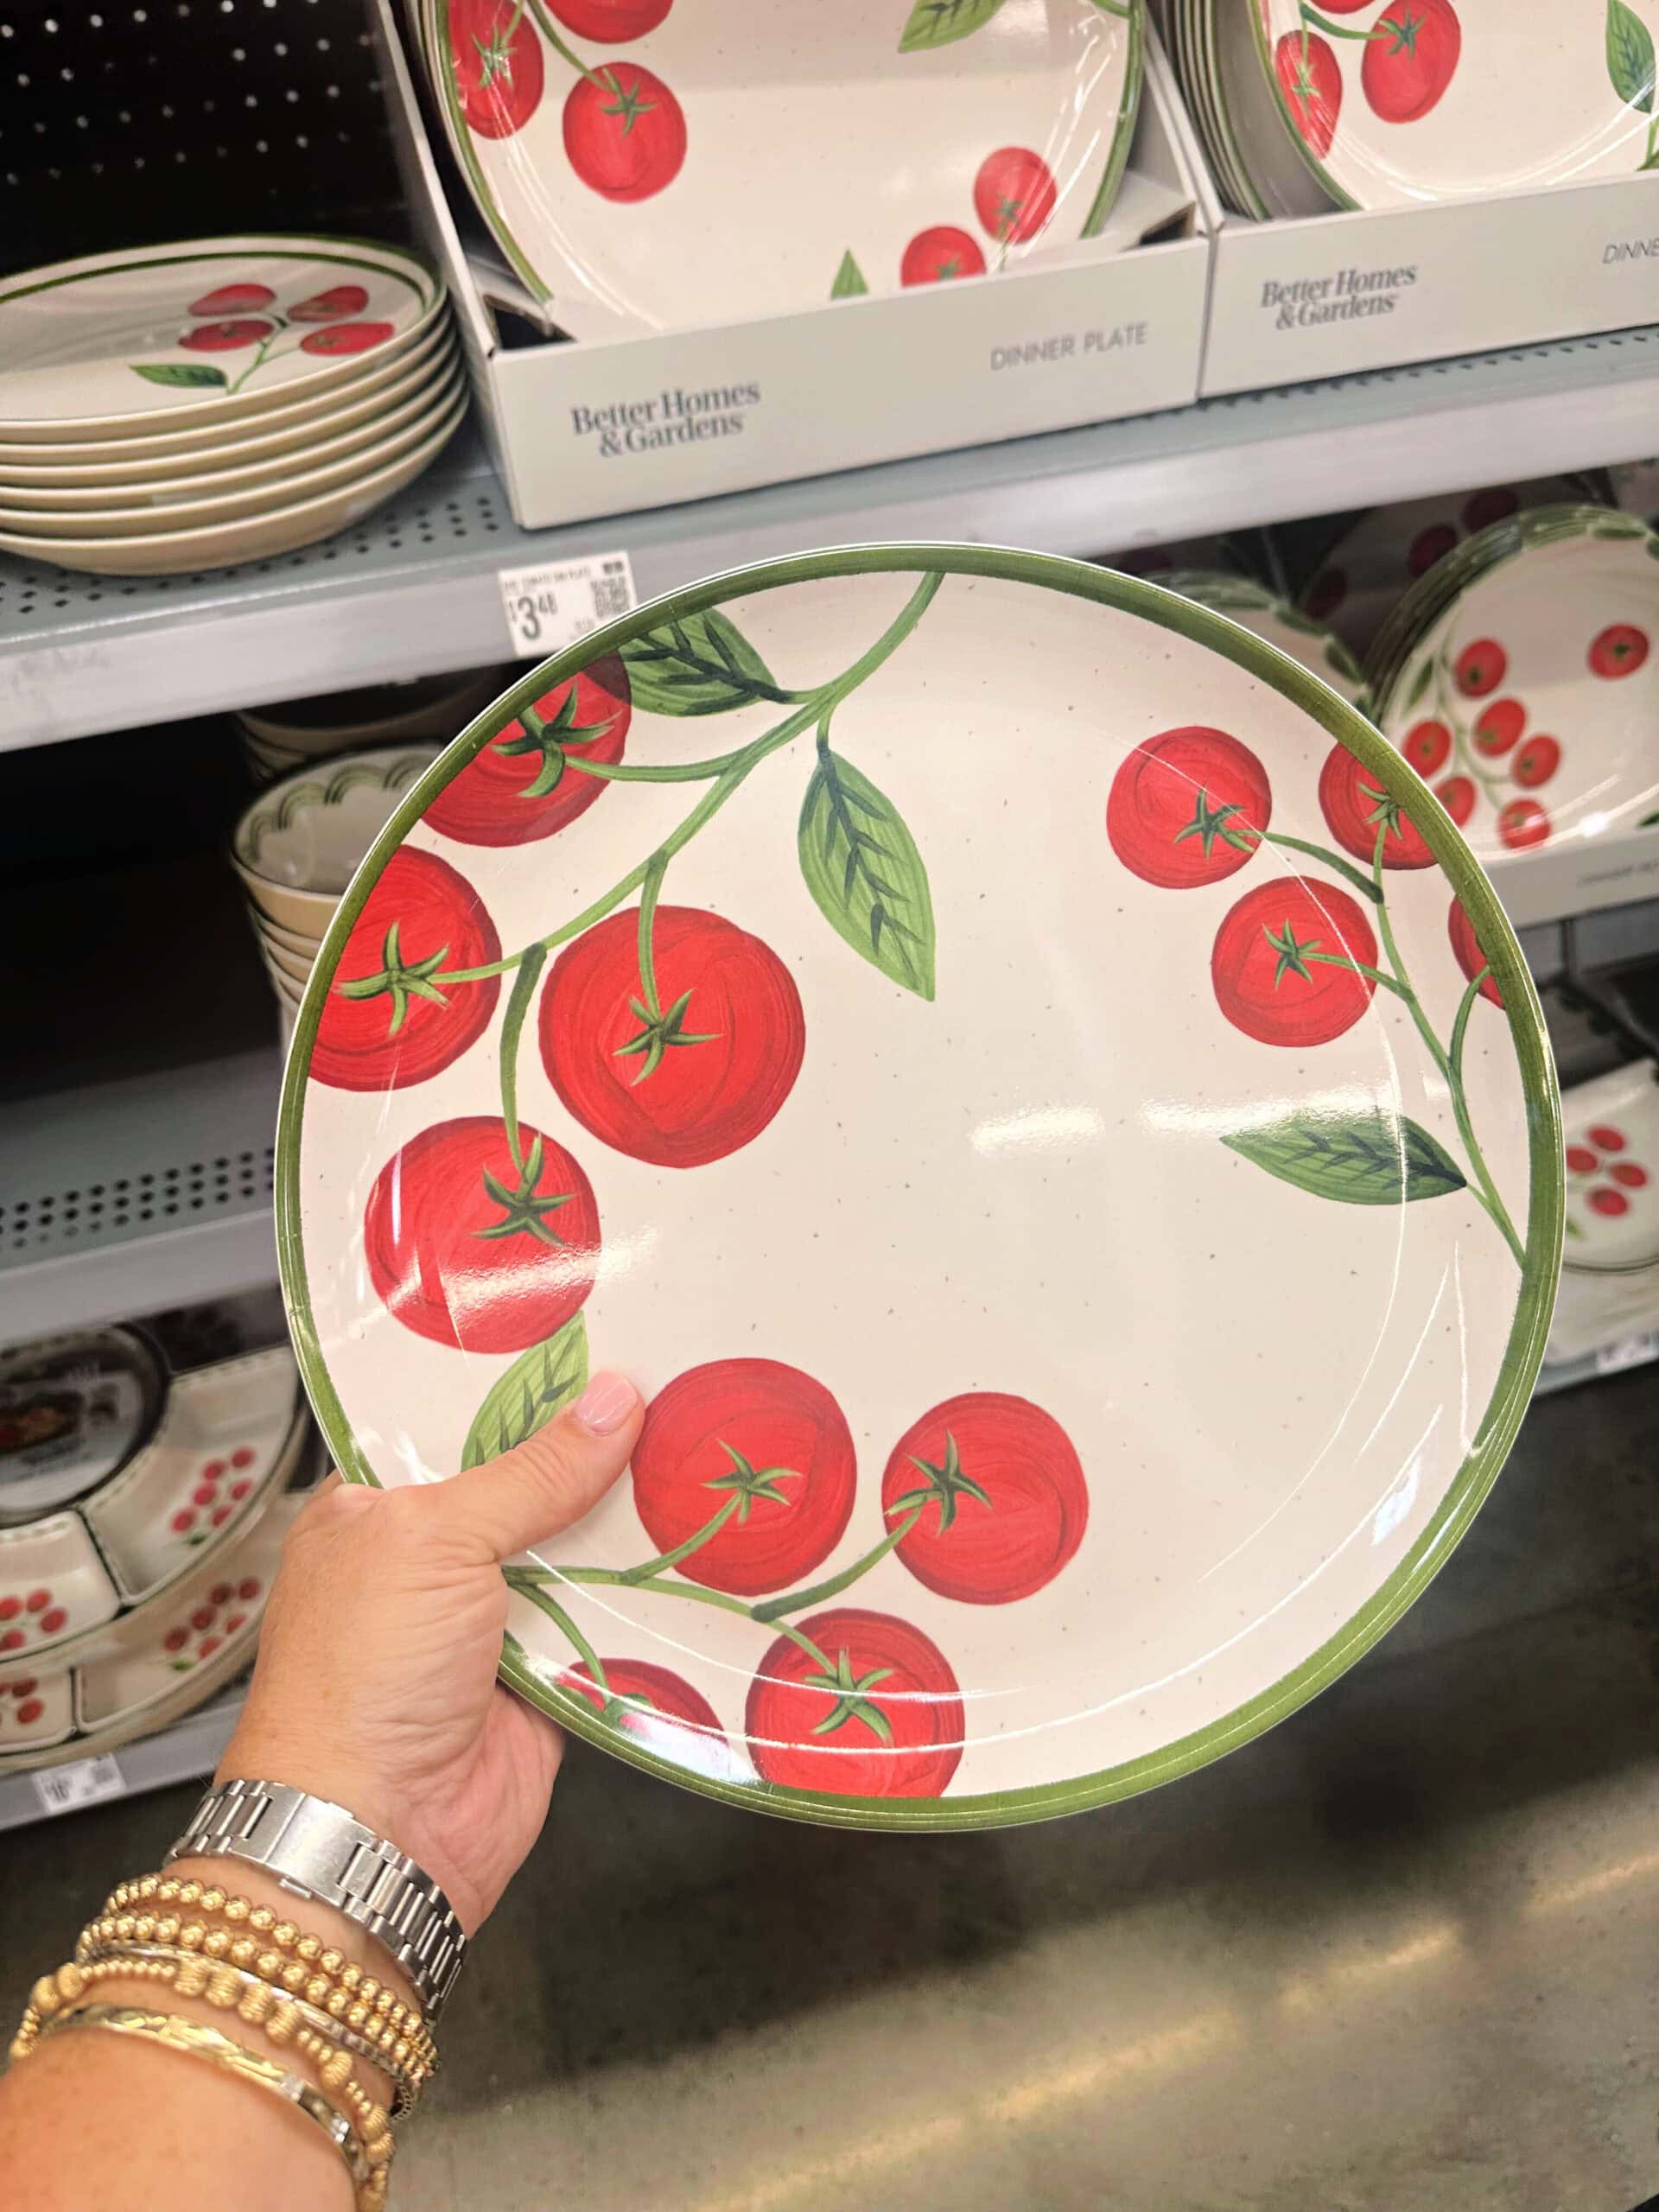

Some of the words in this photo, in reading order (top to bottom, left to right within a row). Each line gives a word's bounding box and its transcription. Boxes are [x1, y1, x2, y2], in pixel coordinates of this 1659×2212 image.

[1261, 277, 1333, 308] Better
[1336, 265, 1418, 297] Homes
[1298, 294, 1399, 327] Gardens
[990, 334, 1075, 372] DINNER
[1084, 319, 1148, 353] PLATE
[570, 399, 656, 435] Better
[660, 382, 761, 420] Homes
[625, 412, 743, 454] Gardens
